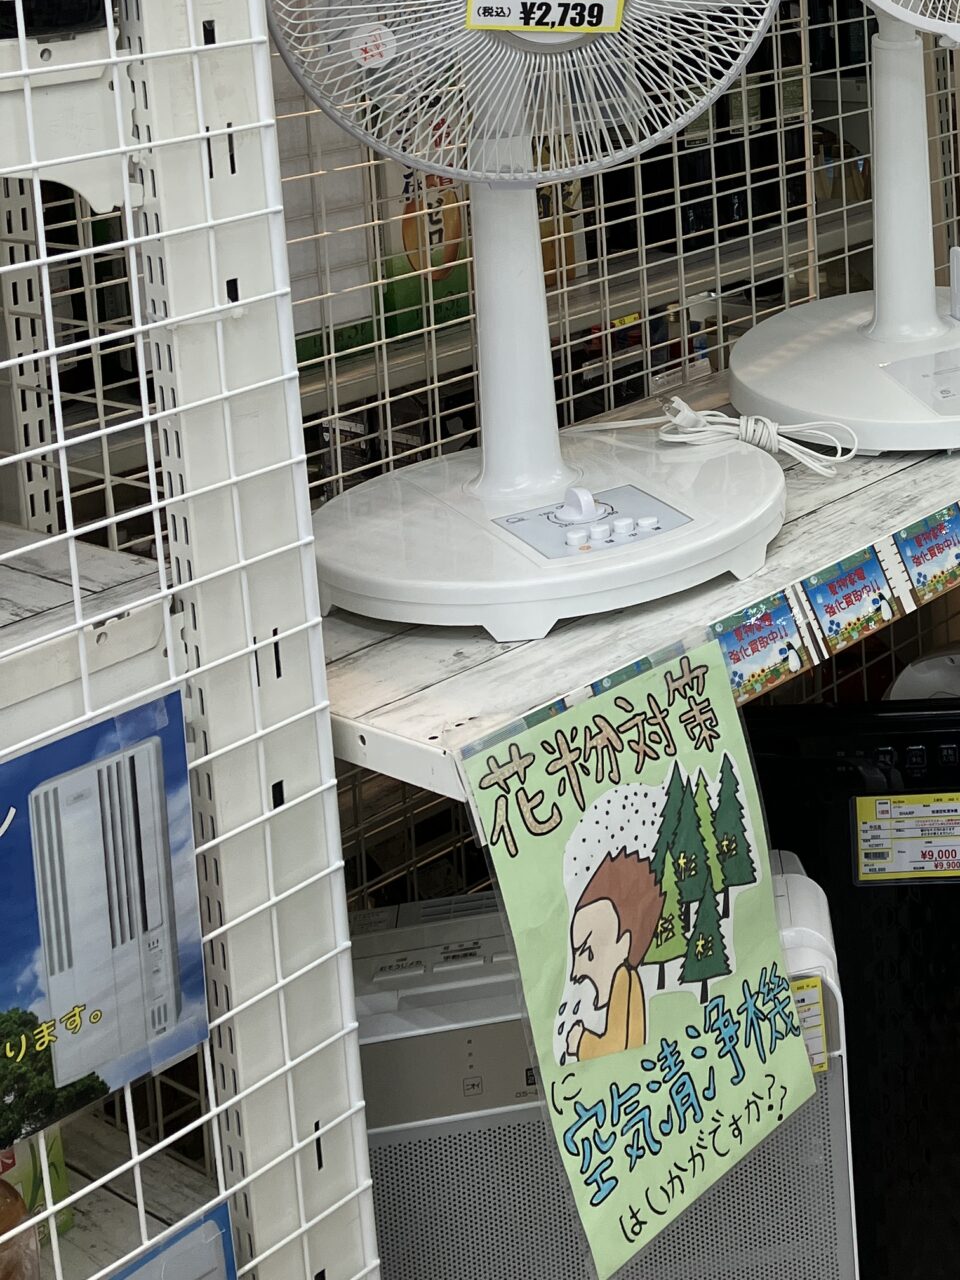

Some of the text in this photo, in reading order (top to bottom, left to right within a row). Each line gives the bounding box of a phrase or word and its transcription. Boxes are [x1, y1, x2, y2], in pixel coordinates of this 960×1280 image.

[477, 1, 604, 29] (税込) ¥2,739
[479, 656, 721, 858] 花粉対策
[920, 849, 958, 861] ¥9,000
[934, 861, 960, 870] ¥9,900
[551, 1073, 582, 1115] に
[563, 961, 801, 1208] 空気清浄機
[620, 1073, 788, 1243] はいかがですか??
